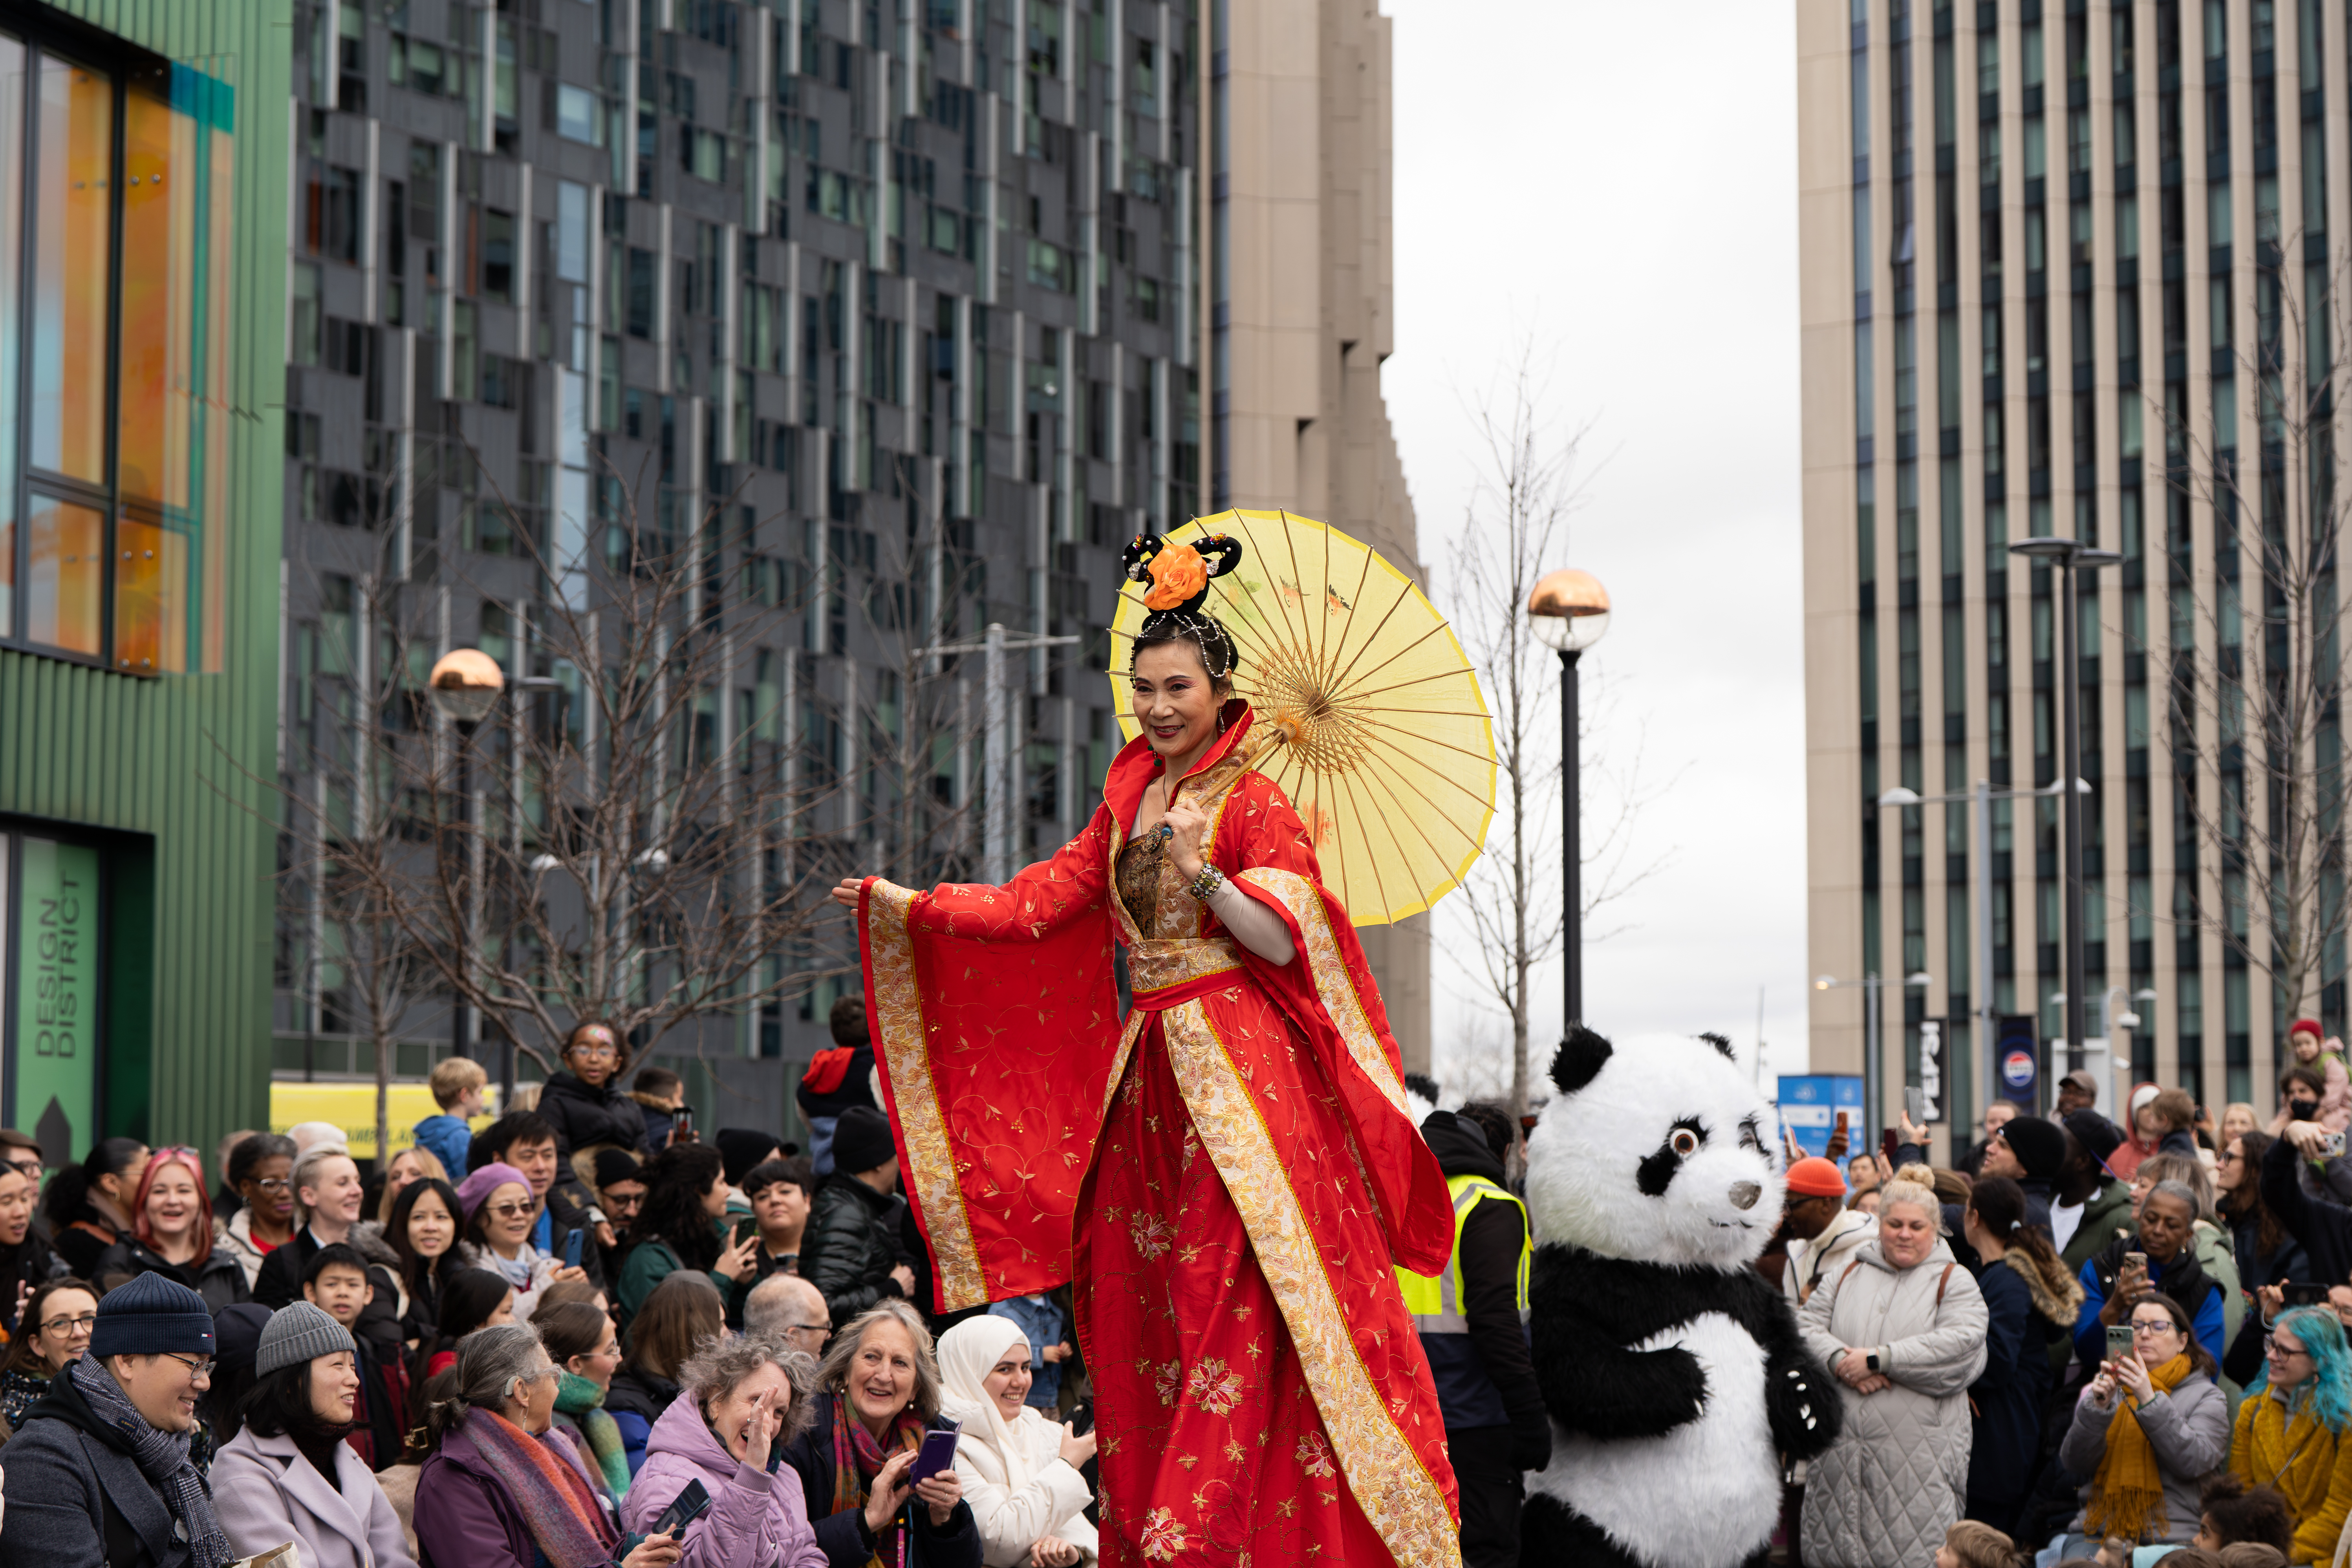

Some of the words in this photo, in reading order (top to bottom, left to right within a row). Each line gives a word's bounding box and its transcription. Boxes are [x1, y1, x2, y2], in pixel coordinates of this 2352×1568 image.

[36, 898, 58, 1057] DESIGN
[57, 869, 79, 1058] DISTRICT
[1920, 1021, 1940, 1120] PEPSI
